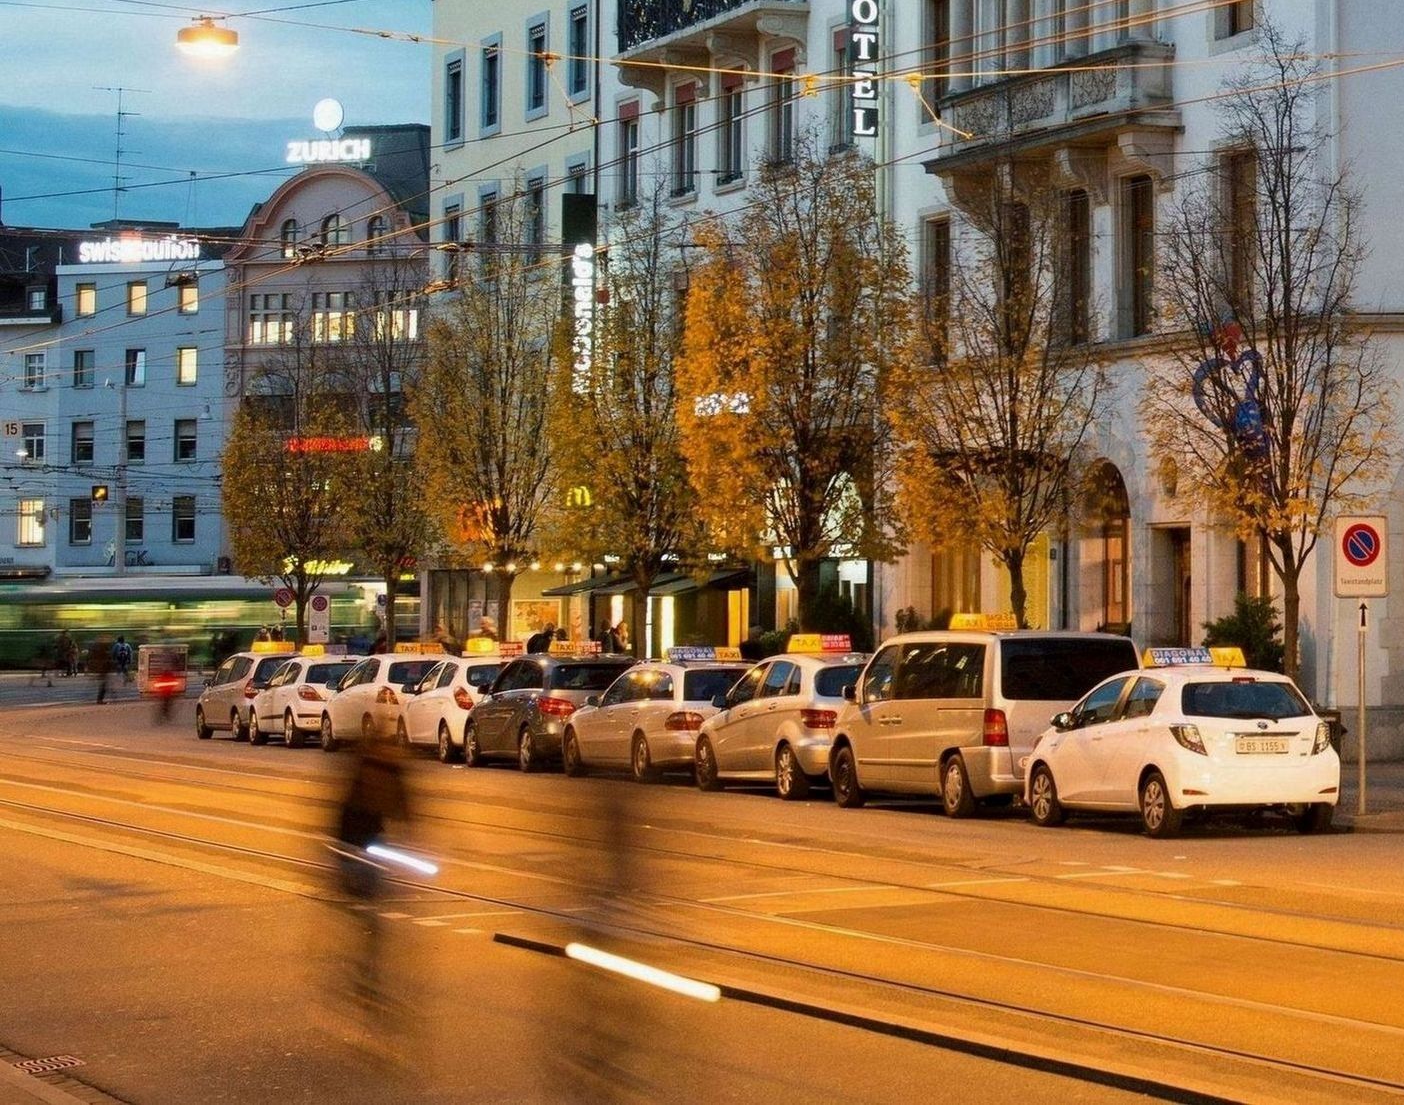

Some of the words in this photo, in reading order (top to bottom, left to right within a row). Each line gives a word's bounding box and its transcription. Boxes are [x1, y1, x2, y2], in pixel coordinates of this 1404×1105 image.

[285, 138, 371, 163] ZURICH
[5, 423, 18, 436] 15
[1340, 577, 1383, 586] Taxistandplatz
[401, 645, 418, 653] TAXI
[1152, 649, 1208, 657] DIAGONAL
[718, 651, 740, 659] TAXI
[1246, 742, 1256, 751] BS
